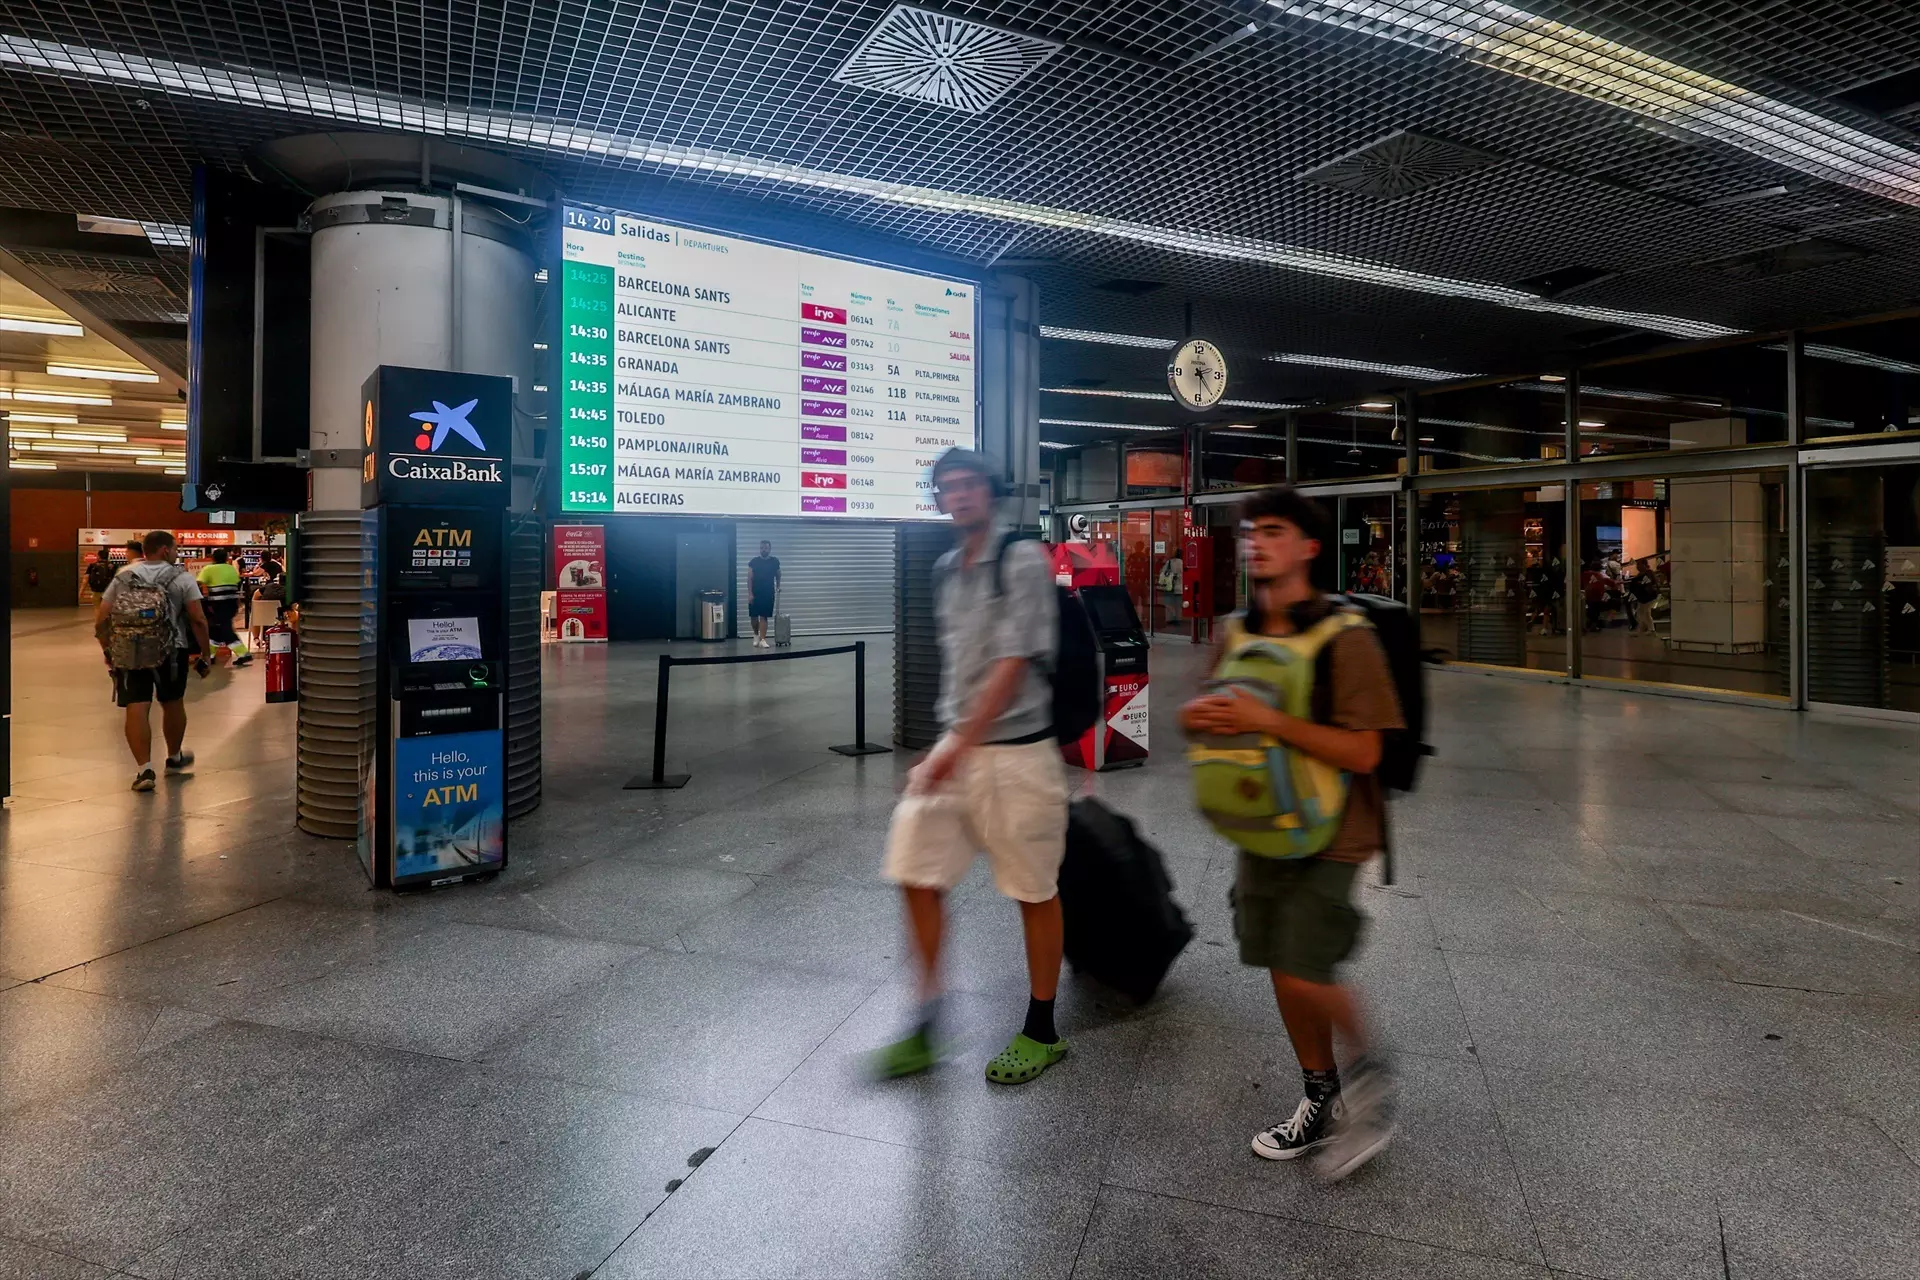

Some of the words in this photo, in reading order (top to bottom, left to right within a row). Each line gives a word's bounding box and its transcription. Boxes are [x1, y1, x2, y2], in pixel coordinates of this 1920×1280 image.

[620, 223, 670, 242] Salidas
[684, 238, 728, 254] DEPARTURES
[566, 242, 584, 252] Hora
[618, 251, 645, 262] Destino
[618, 276, 690, 298] BARCELONA
[694, 288, 730, 304] SANTS
[851, 292, 872, 301] Número
[618, 303, 676, 321] ALICANTE
[814, 307, 834, 320] iryo
[915, 303, 950, 315] Observaciones
[851, 315, 874, 325] 06141
[570, 325, 608, 339] 14:30
[949, 331, 970, 341] SALIDA
[618, 330, 690, 350] BARCELONA
[694, 339, 730, 354] SANTS
[822, 337, 844, 346] AVE
[851, 338, 874, 348] 05742
[1195, 346, 1204, 354] 12
[570, 352, 607, 366] 14:35
[803, 353, 820, 361] renfe
[949, 352, 970, 362] SALIDA
[617, 357, 679, 374] GRANADA
[822, 360, 844, 369] AVE
[851, 362, 874, 372] 03143
[888, 365, 900, 376] 5A
[1176, 368, 1182, 376] 9
[570, 380, 607, 394] 14:35
[822, 384, 844, 393] AVE
[851, 385, 874, 395] 02146
[888, 387, 906, 399] 11B
[618, 382, 670, 399] MÁLAGA
[675, 386, 714, 403] MARÍA
[718, 393, 781, 410] ZAMBRANO
[570, 408, 607, 421] 14:45
[617, 410, 665, 425] TOLEDO
[822, 408, 844, 416] AVE
[851, 408, 874, 417] 02142
[888, 410, 906, 422] 11A
[570, 435, 607, 448] 14:50
[851, 432, 874, 441] 08142
[916, 437, 939, 445] PLANTA
[618, 438, 729, 456] PAMPLONA/IRUÑA
[851, 455, 874, 464] 00609
[389, 458, 502, 482] CaixaBank
[570, 464, 607, 476] 15:07
[618, 463, 670, 479] MÁLAGA
[675, 466, 714, 481] MARÍA
[718, 469, 781, 484] ZAMBRANO
[814, 474, 834, 486] iryo
[851, 478, 874, 486] 06148
[570, 491, 607, 503] 15:14
[617, 492, 684, 506] ALGECIRAS
[851, 501, 874, 510] 09330
[414, 528, 472, 547] ATM
[1119, 683, 1138, 692] EURO
[1130, 711, 1147, 720] EURO
[432, 750, 470, 765] Hello,
[413, 768, 439, 783] this
[442, 767, 453, 779] is
[457, 764, 487, 779] your
[422, 783, 478, 808] ATM
